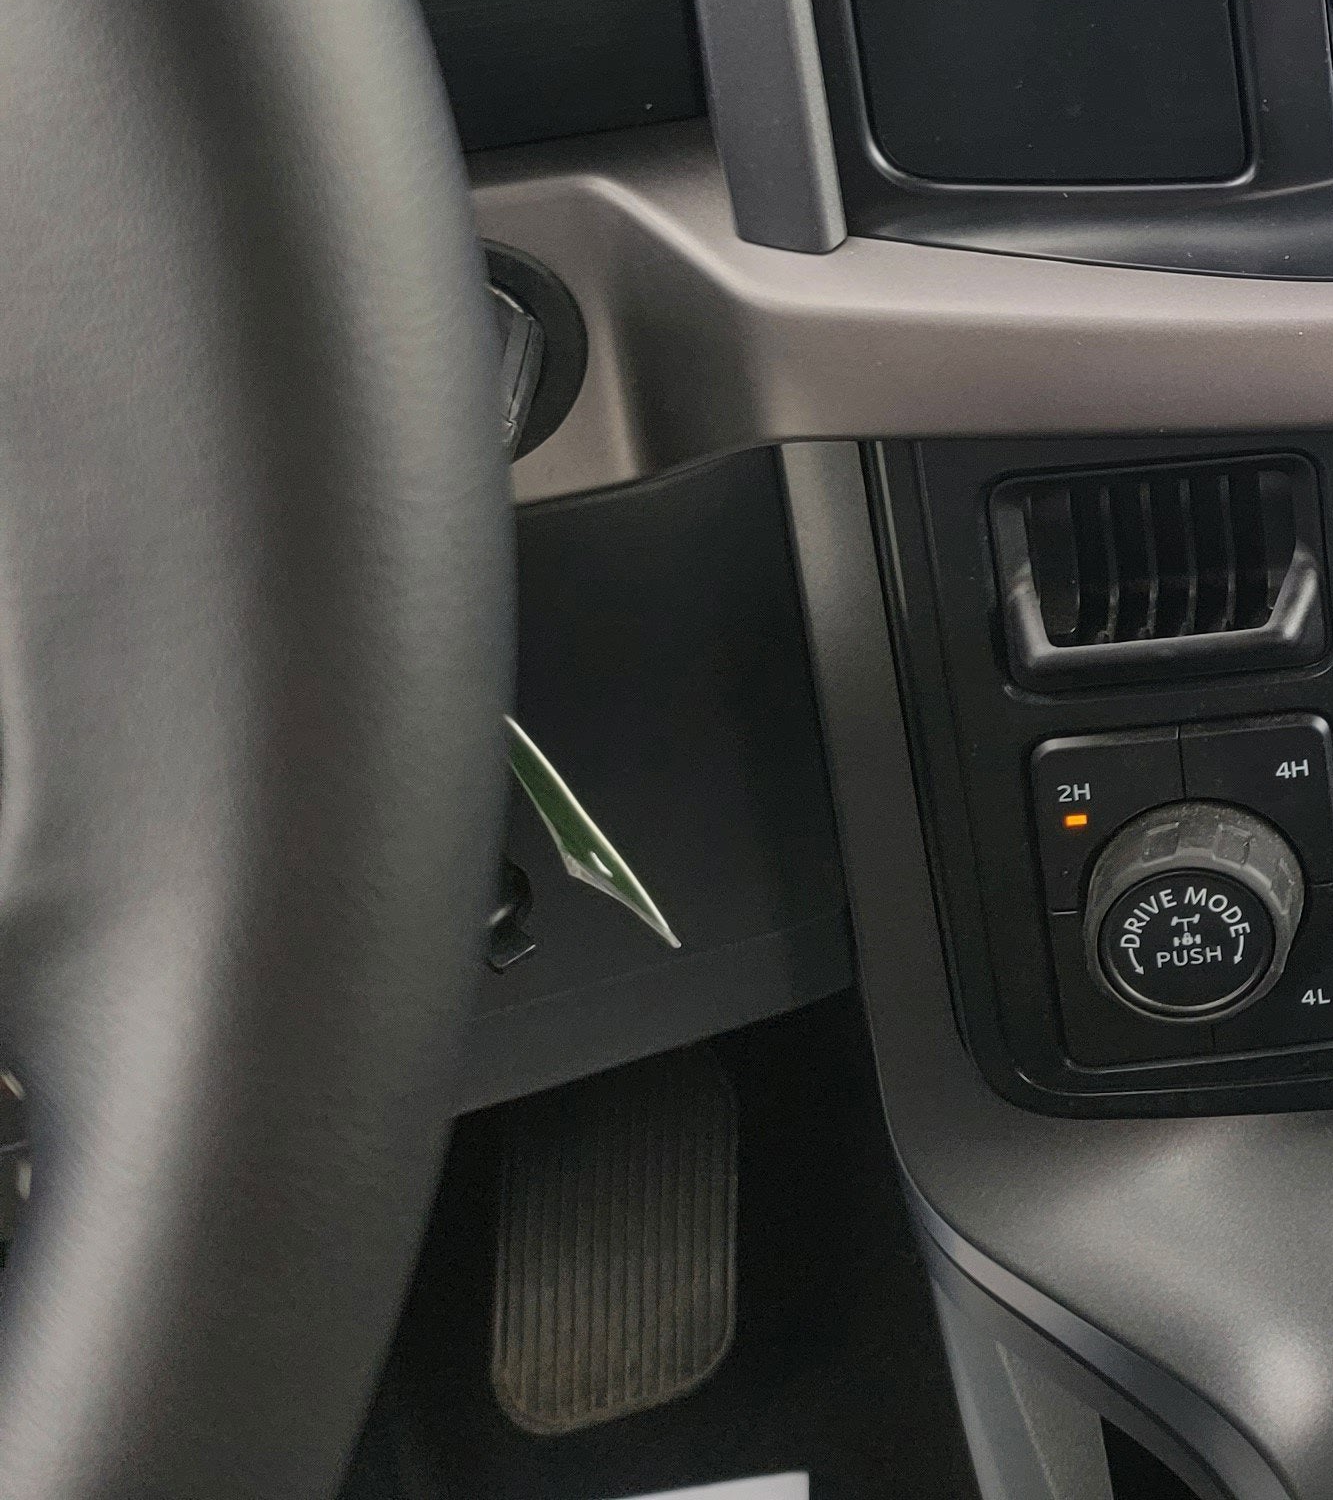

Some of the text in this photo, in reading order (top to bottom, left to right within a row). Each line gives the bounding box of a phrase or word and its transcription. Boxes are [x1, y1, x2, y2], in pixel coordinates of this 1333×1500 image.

[1275, 759, 1309, 779] 4H
[1056, 782, 1091, 803] 2H
[1120, 886, 1250, 949] DRIVE MODE
[1156, 946, 1222, 968] PUSH
[1301, 988, 1331, 1006] 4L
